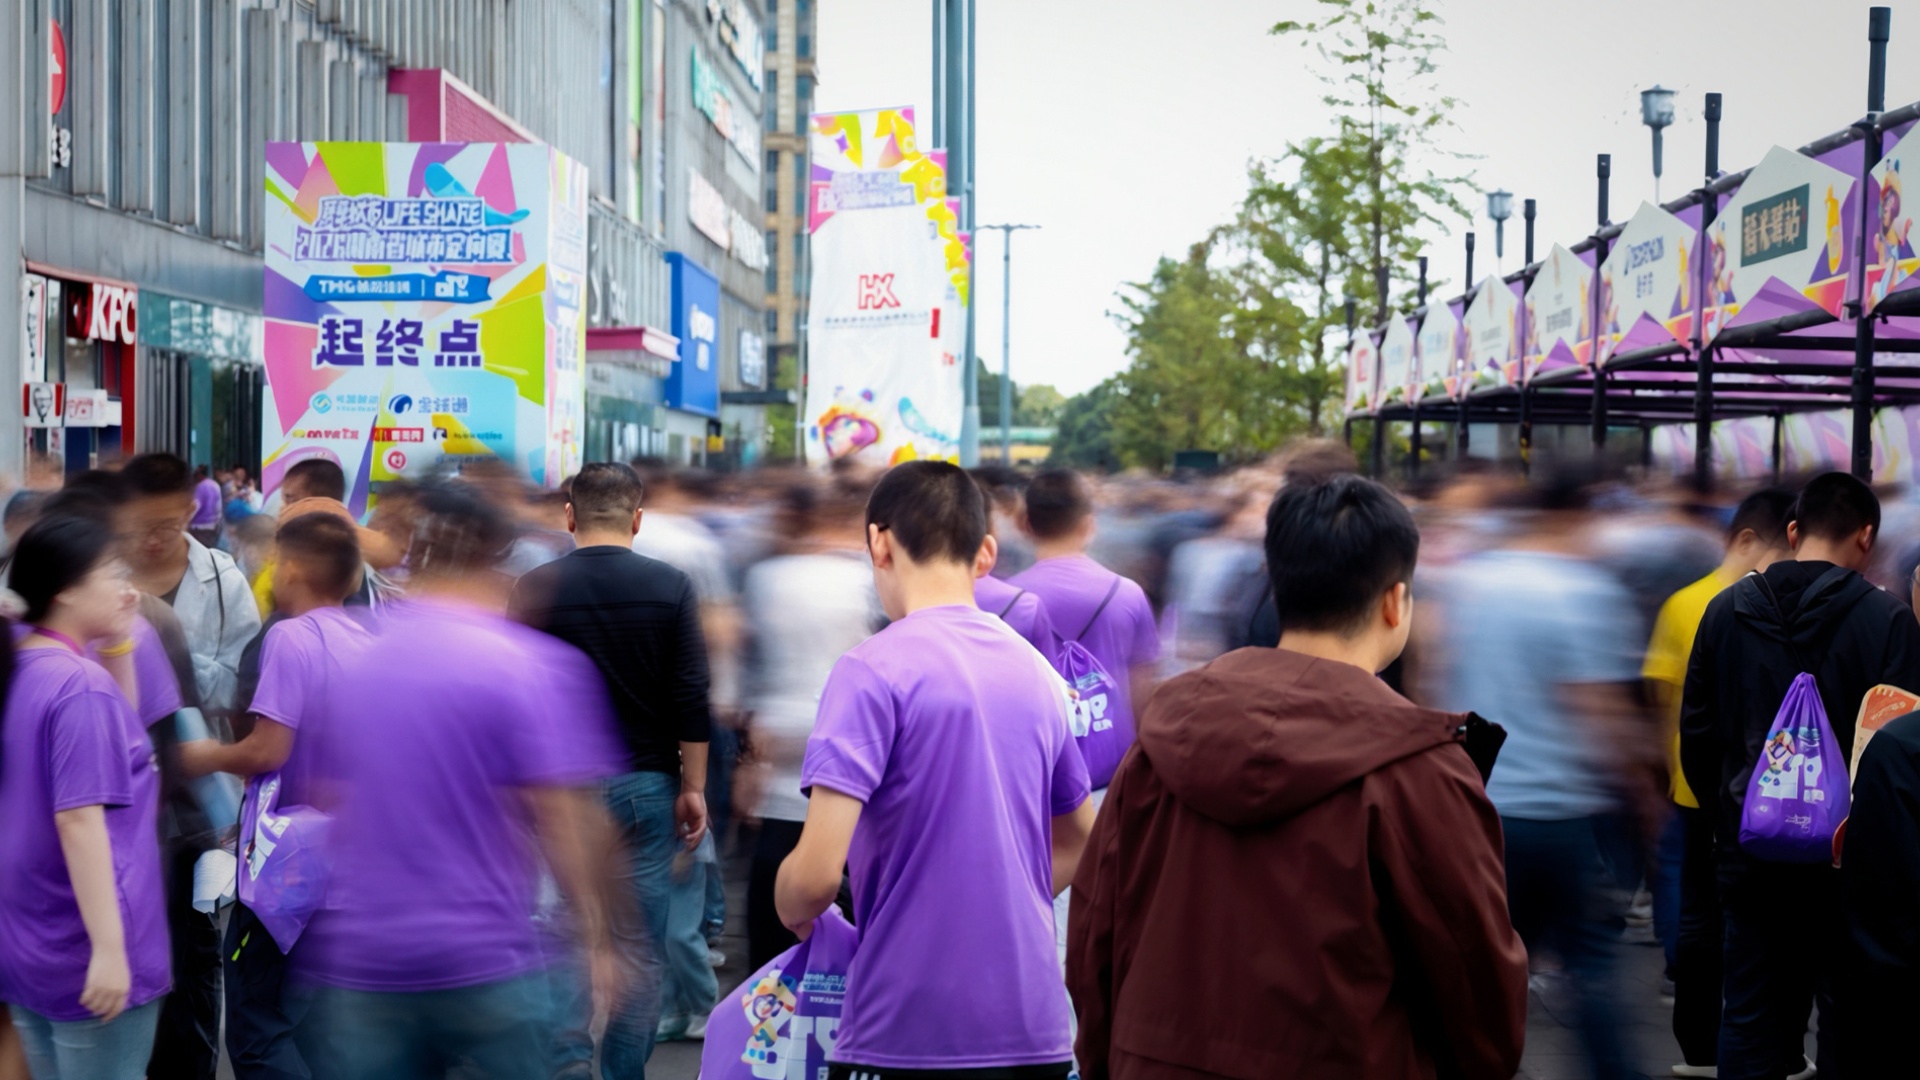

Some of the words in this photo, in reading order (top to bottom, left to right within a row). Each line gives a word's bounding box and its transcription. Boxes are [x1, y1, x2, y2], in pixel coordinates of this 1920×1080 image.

[89, 282, 136, 345] KFC
[316, 318, 482, 367] 起终点
